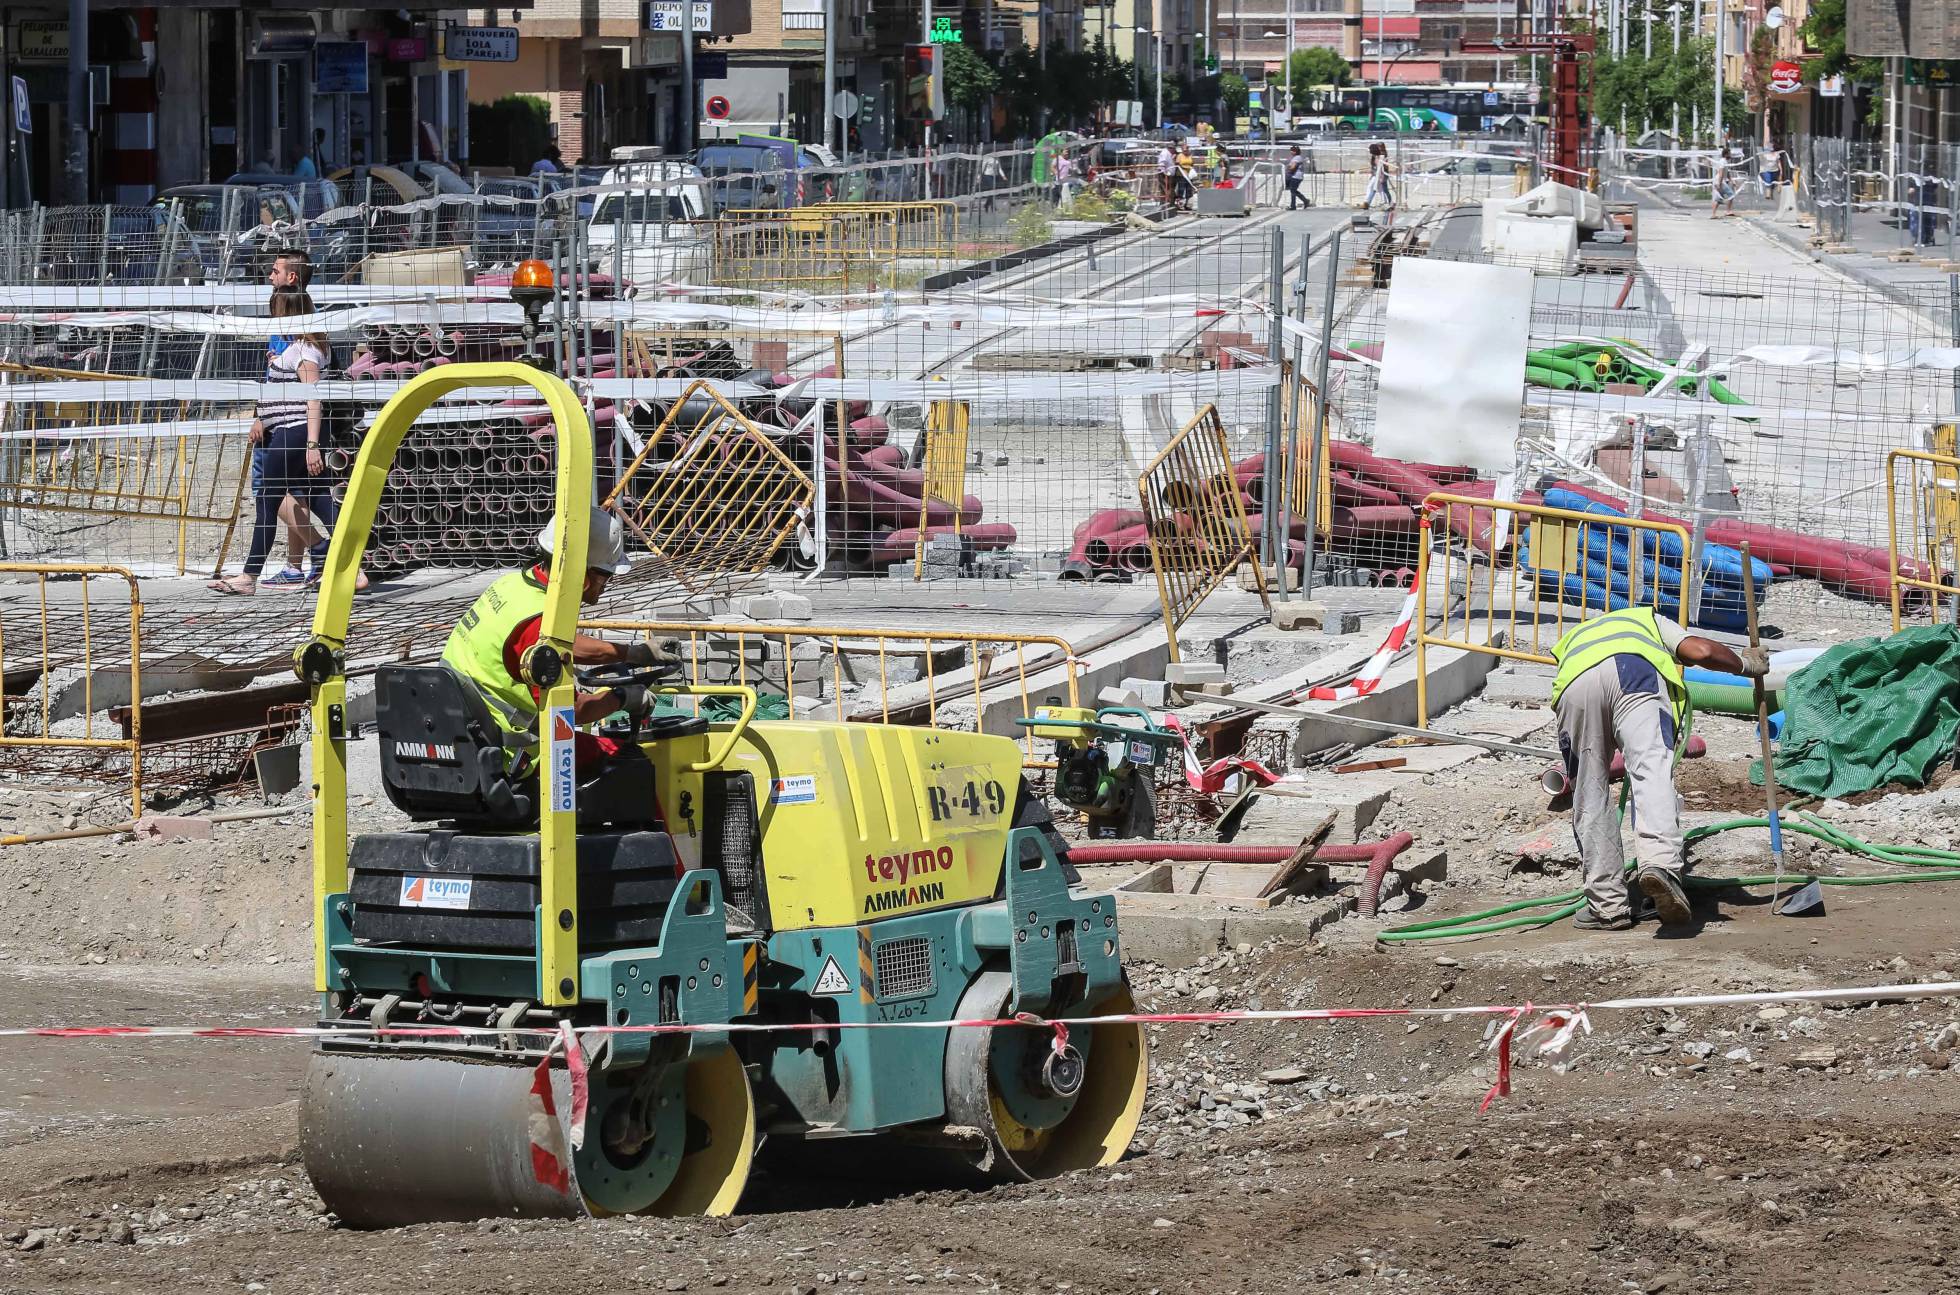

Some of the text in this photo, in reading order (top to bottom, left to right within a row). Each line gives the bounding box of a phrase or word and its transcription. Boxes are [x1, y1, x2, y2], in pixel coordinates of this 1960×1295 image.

[655, 3, 707, 12] DEPOES
[668, 16, 708, 27] OLPO
[930, 30, 962, 42] MAC
[17, 84, 27, 123] P
[395, 741, 455, 760] AMMANN
[560, 747, 573, 810] teymo
[786, 778, 812, 787] teymo
[864, 845, 954, 885] teymo
[429, 879, 470, 897] teymo
[863, 881, 945, 914] AMMANN
